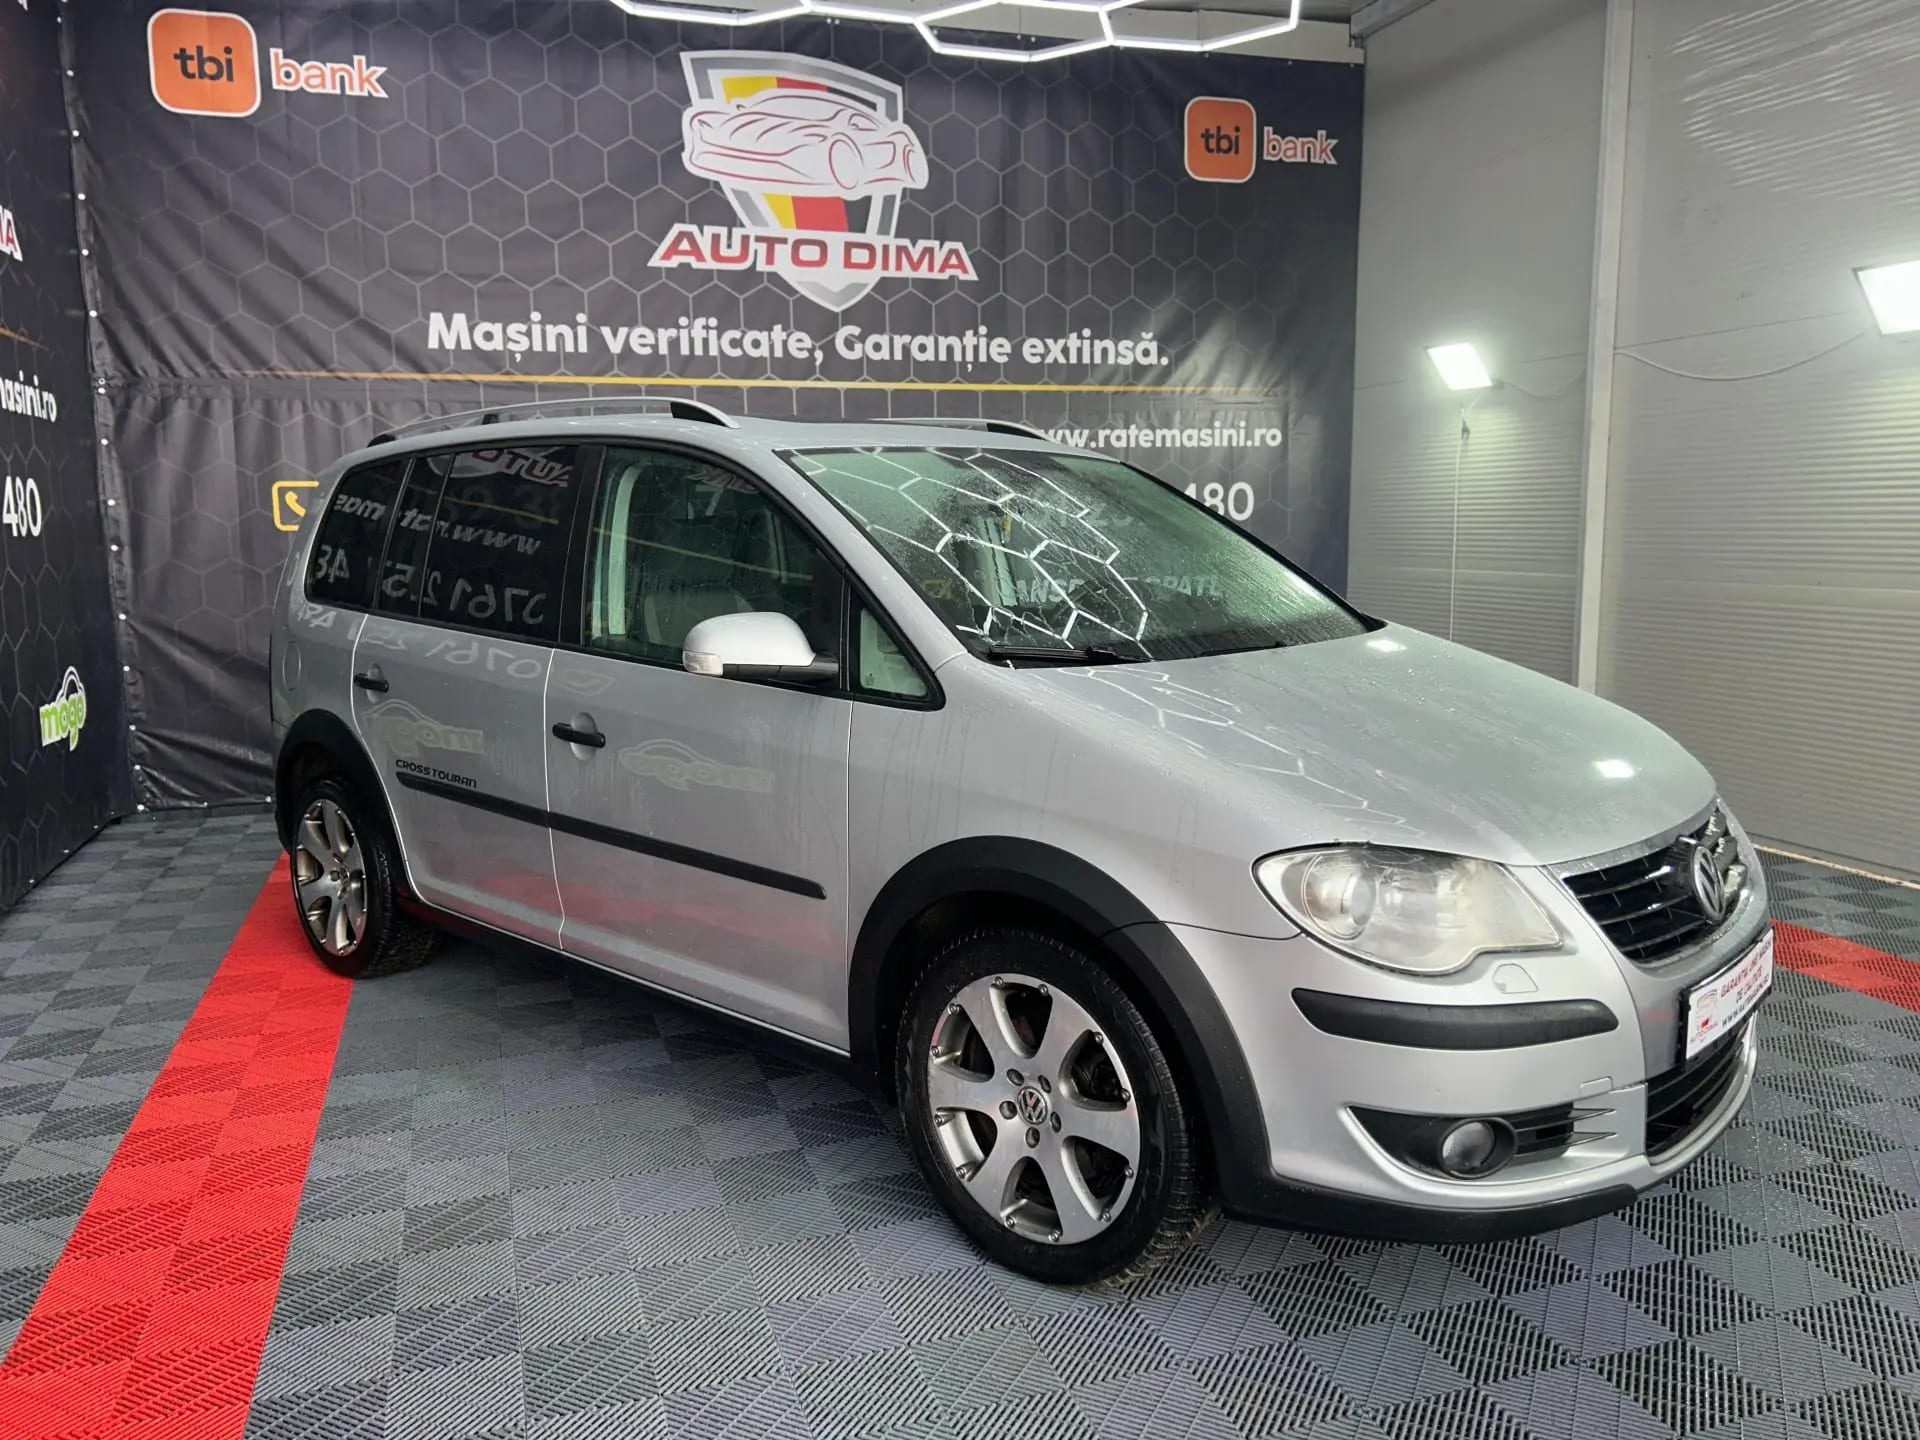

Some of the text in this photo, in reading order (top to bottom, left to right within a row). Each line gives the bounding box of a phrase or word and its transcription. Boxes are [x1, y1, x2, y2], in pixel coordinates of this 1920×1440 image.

[172, 45, 390, 99] tbi bank
[1200, 125, 1339, 165] tbi bank
[656, 228, 971, 276] AUTO DIMA
[427, 311, 1169, 372] Mașini verificate, Garanție extinsă.
[1040, 421, 1283, 449] ww.ratemasini.ro
[2, 476, 42, 537] 480
[39, 690, 87, 752] mogo
